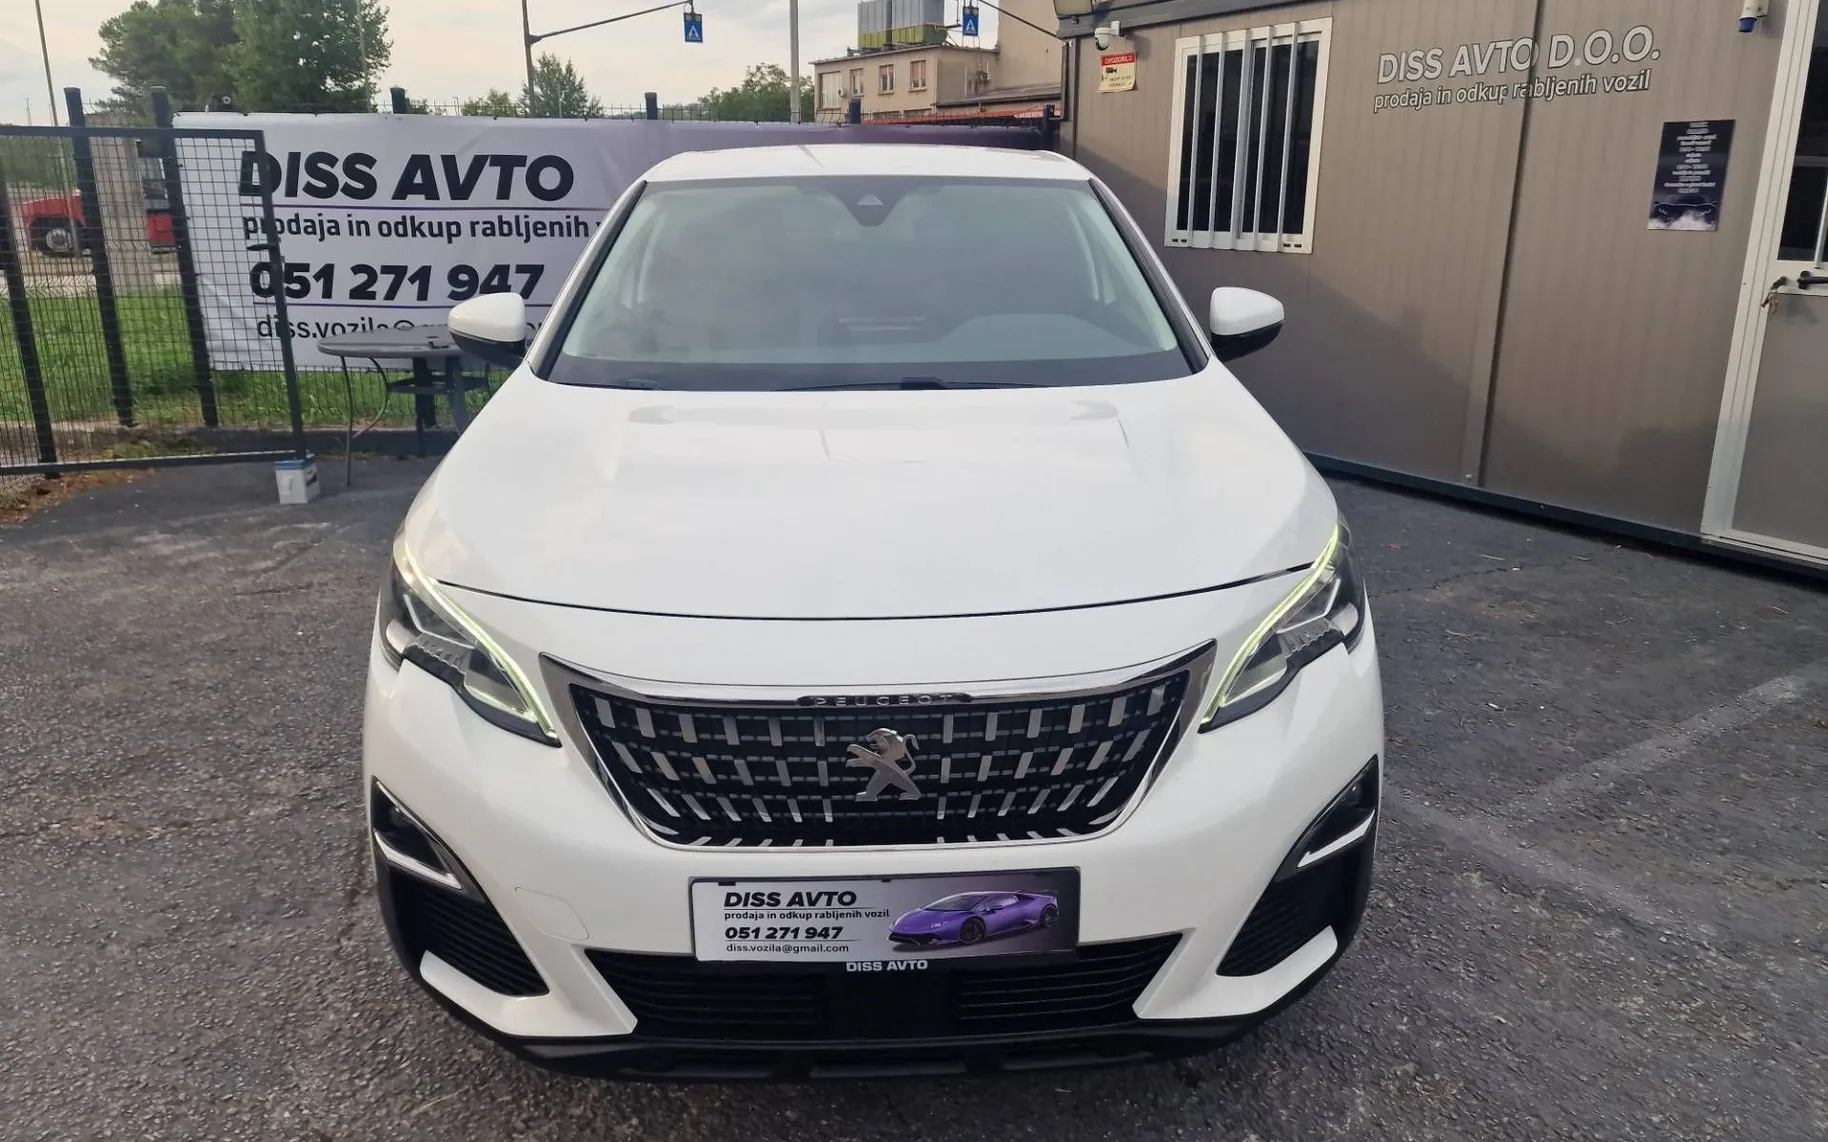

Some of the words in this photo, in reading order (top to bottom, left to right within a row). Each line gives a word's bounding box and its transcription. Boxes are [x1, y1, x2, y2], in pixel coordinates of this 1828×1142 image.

[1377, 47, 1443, 84] DISS
[1448, 37, 1539, 78] AVTO
[1547, 24, 1660, 69] D.O.O.
[1373, 87, 1432, 113] prodaja
[1436, 85, 1453, 105] in
[1456, 81, 1508, 105] odkup
[1512, 72, 1597, 102] rabljenih
[1602, 67, 1651, 93] vozil
[239, 150, 377, 200] DISS
[391, 153, 574, 202] AVTO
[347, 213, 371, 237] in
[378, 215, 462, 244] odkup
[469, 214, 589, 244] rabljenih
[251, 261, 335, 299] 051
[349, 263, 432, 301] 271
[447, 264, 545, 301] 947
[815, 694, 952, 707] PEUGEOT
[724, 891, 781, 908] DISS
[786, 891, 857, 907] AVTO
[724, 911, 765, 921] prodaja
[767, 911, 777, 919] in
[779, 911, 812, 921] odkup
[814, 910, 862, 920] rabljenih
[864, 909, 890, 918] vozil
[725, 927, 761, 939] 051
[765, 927, 801, 939] 271
[804, 926, 843, 939] 947
[726, 943, 849, 954] diss.vozila@gmail.com
[846, 961, 882, 972] DISS
[886, 960, 928, 971] AVTO
